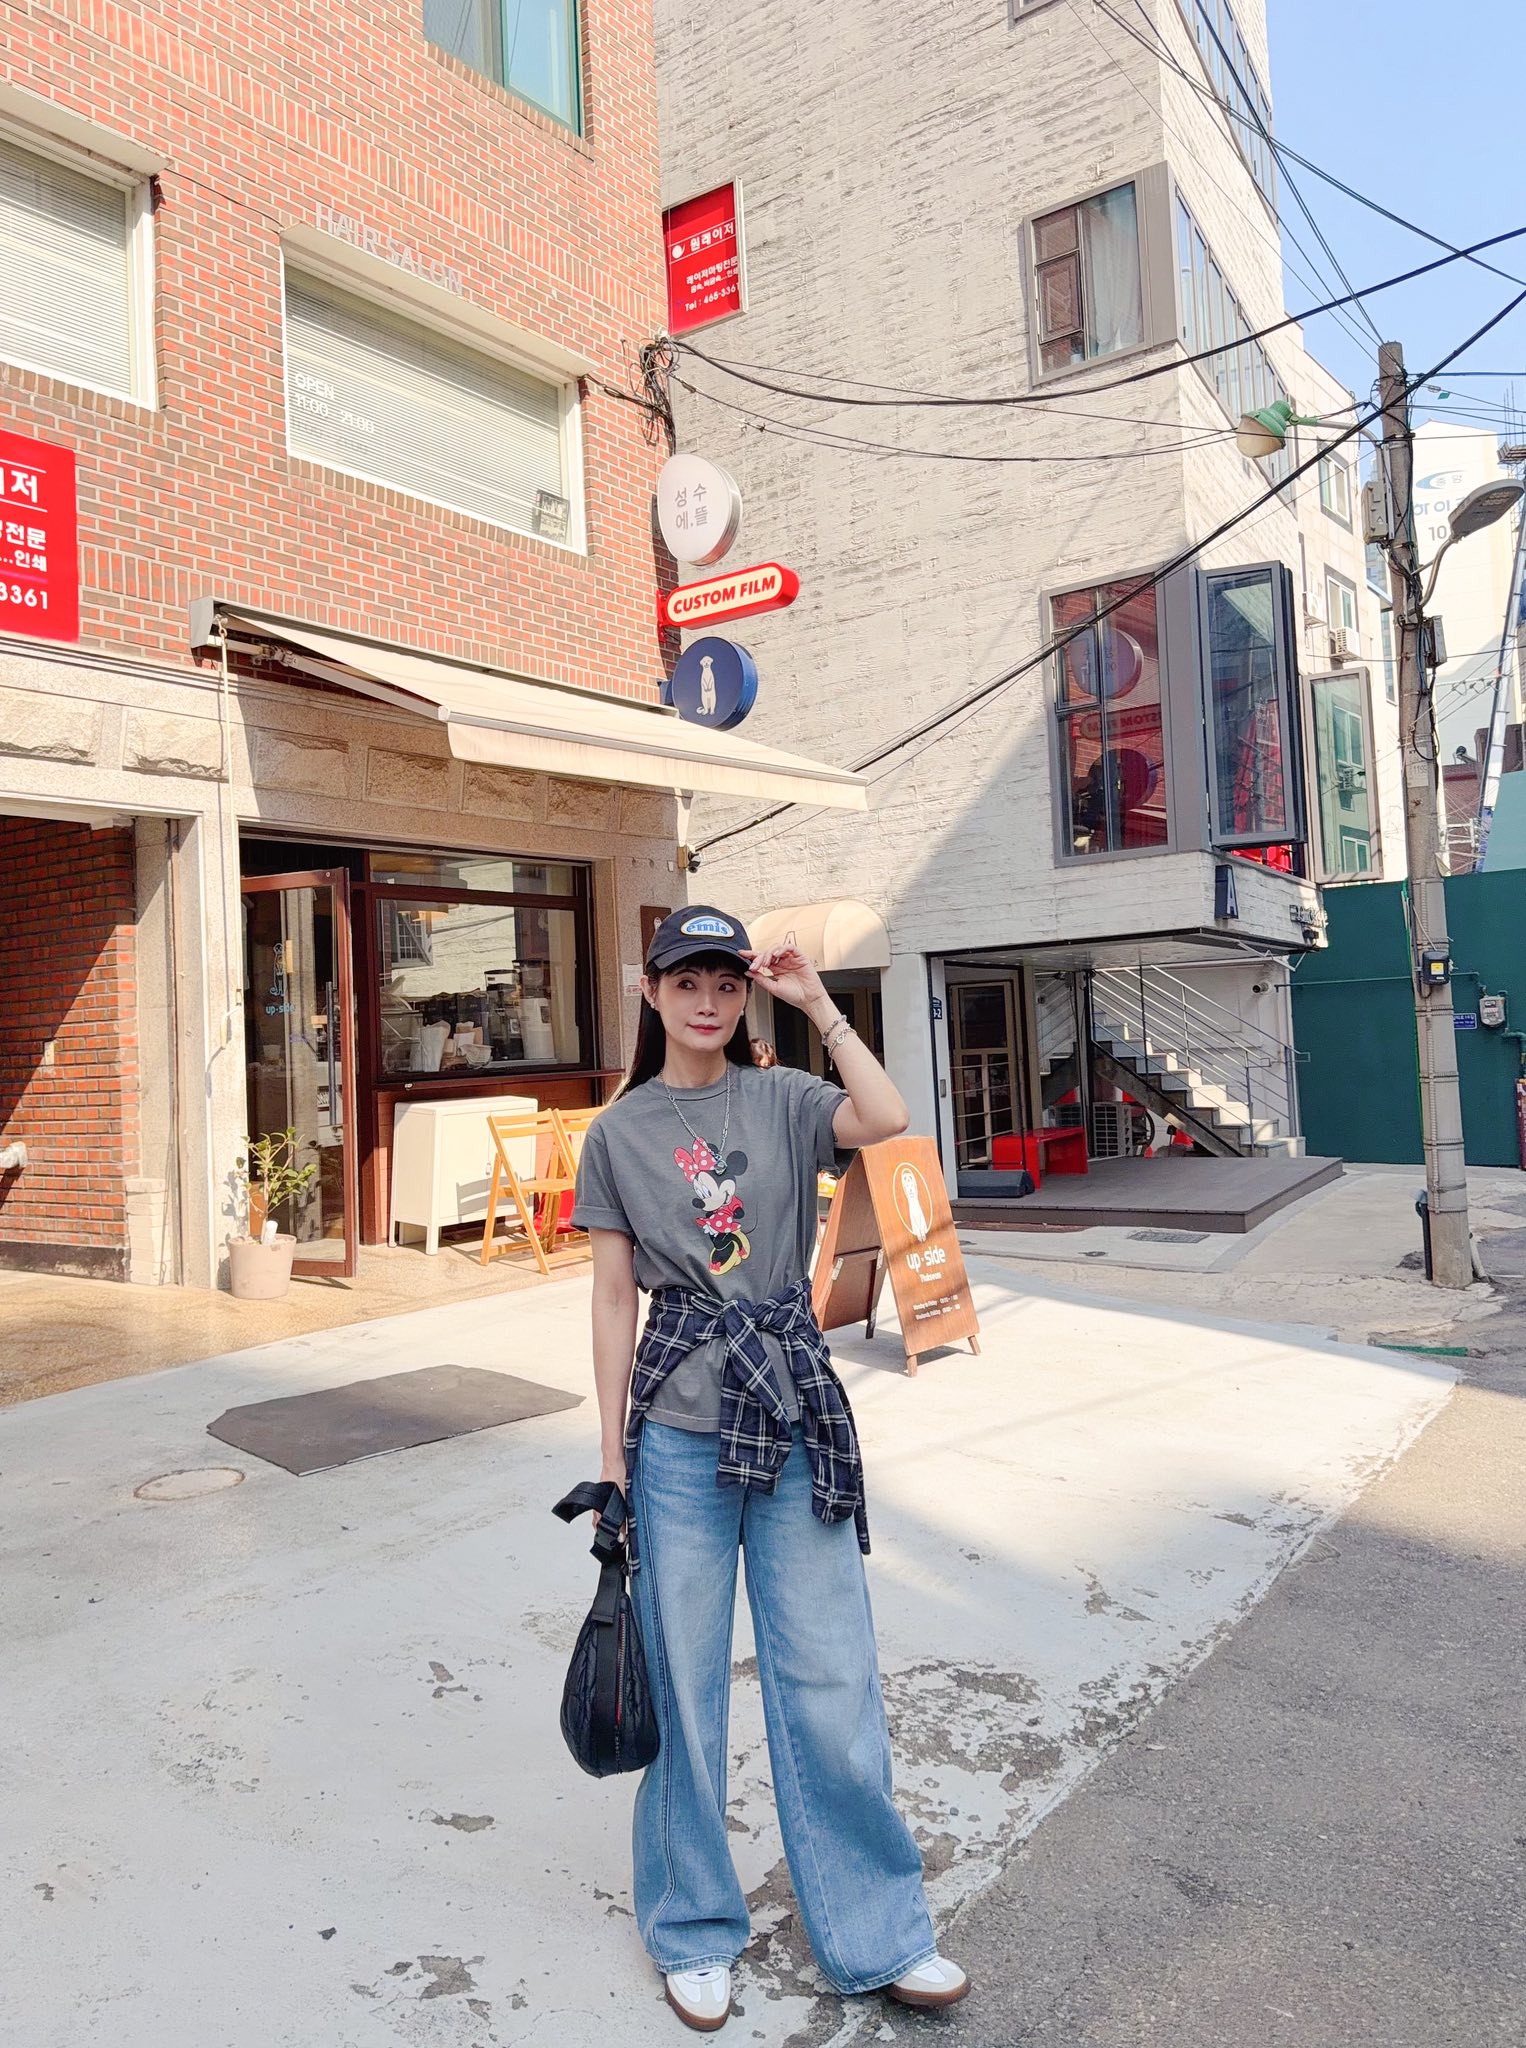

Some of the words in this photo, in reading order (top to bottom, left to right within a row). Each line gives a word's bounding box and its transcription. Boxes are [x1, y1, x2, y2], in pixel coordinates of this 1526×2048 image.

[315, 201, 379, 256] HAIR
[385, 236, 464, 297] SALON
[690, 221, 735, 253] 원레이저
[685, 300, 697, 312] Tel
[295, 373, 335, 400] OPEN
[673, 586, 736, 615] CUSTOM
[739, 574, 776, 598] FILM
[686, 921, 729, 935] emis
